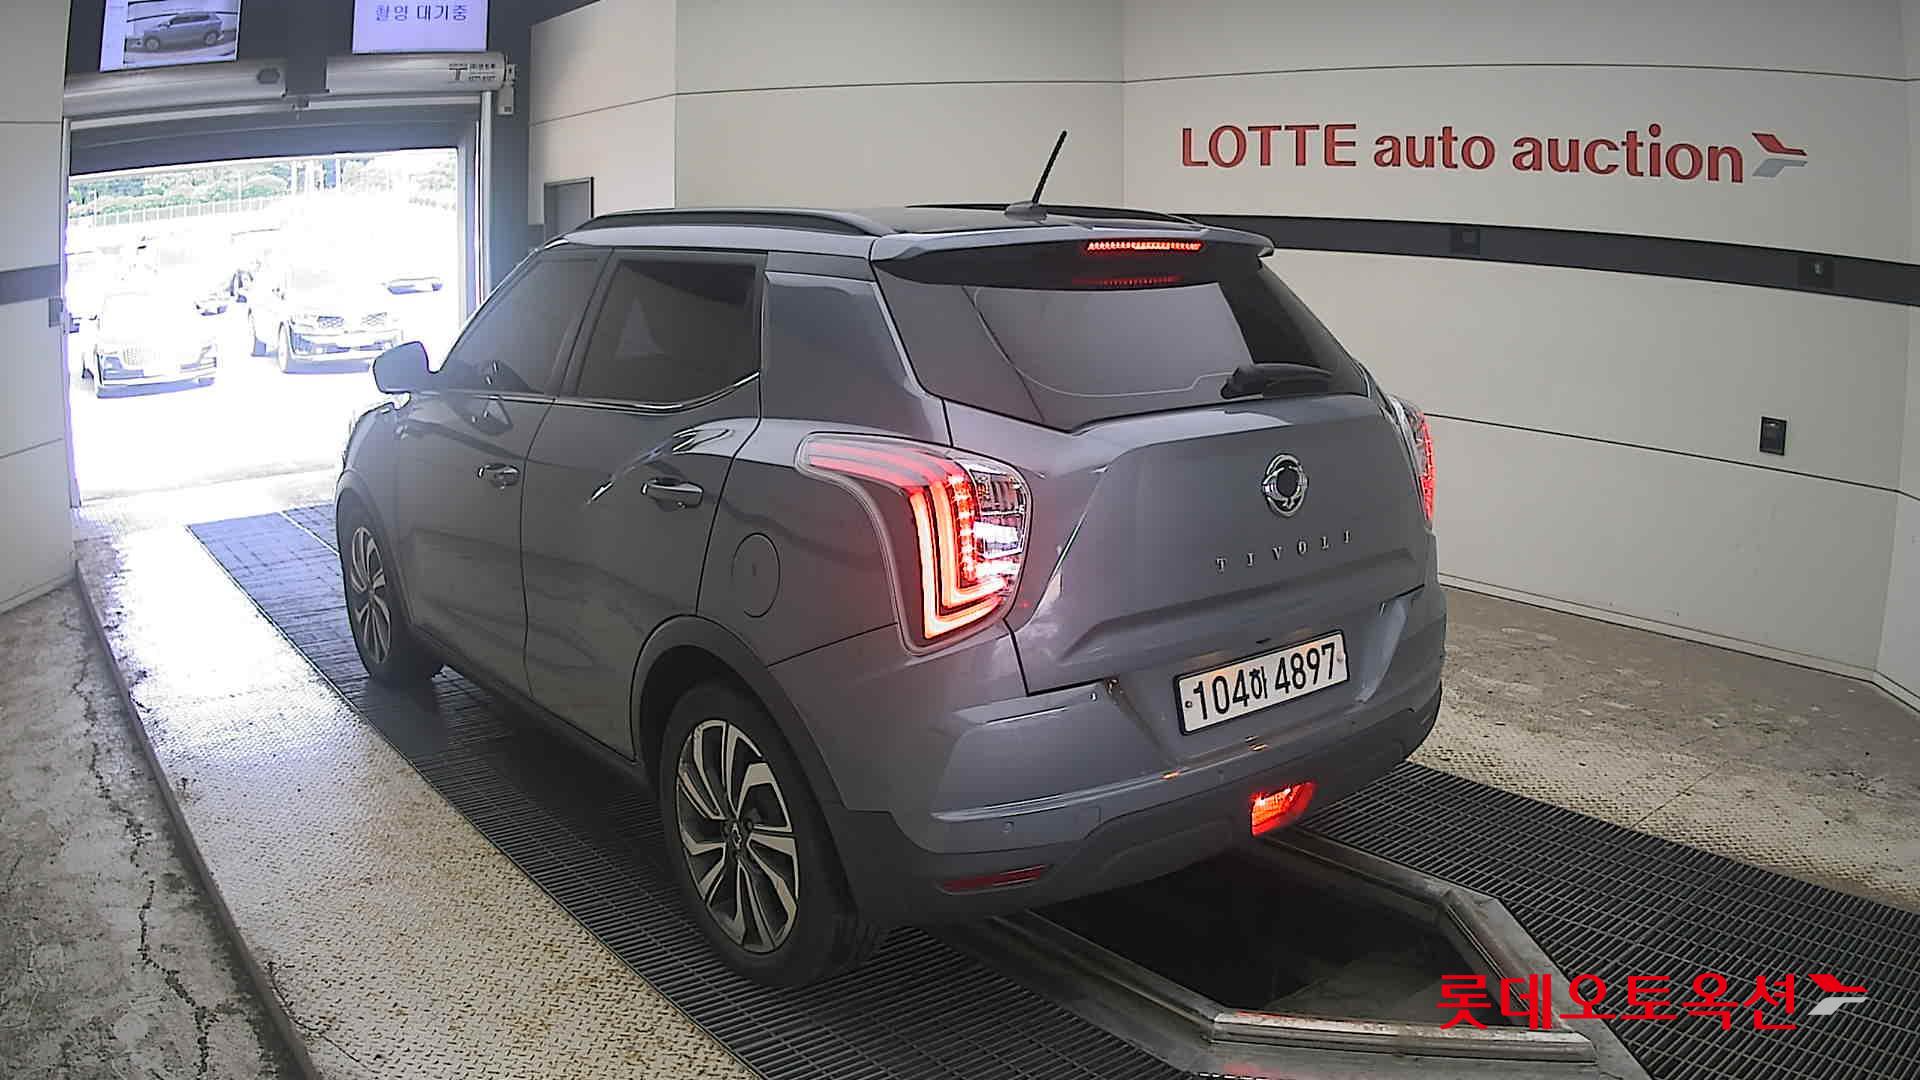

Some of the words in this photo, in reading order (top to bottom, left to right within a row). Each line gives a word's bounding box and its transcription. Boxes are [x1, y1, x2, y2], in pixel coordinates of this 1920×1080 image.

[416, 4, 467, 21] 대기중
[1182, 124, 1357, 168] LOTTE
[1373, 126, 1496, 170] auto
[1512, 123, 1744, 183] auction
[1215, 529, 1350, 573] TIVOLI
[1193, 665, 1268, 720] 104하
[1274, 642, 1335, 695] 4897
